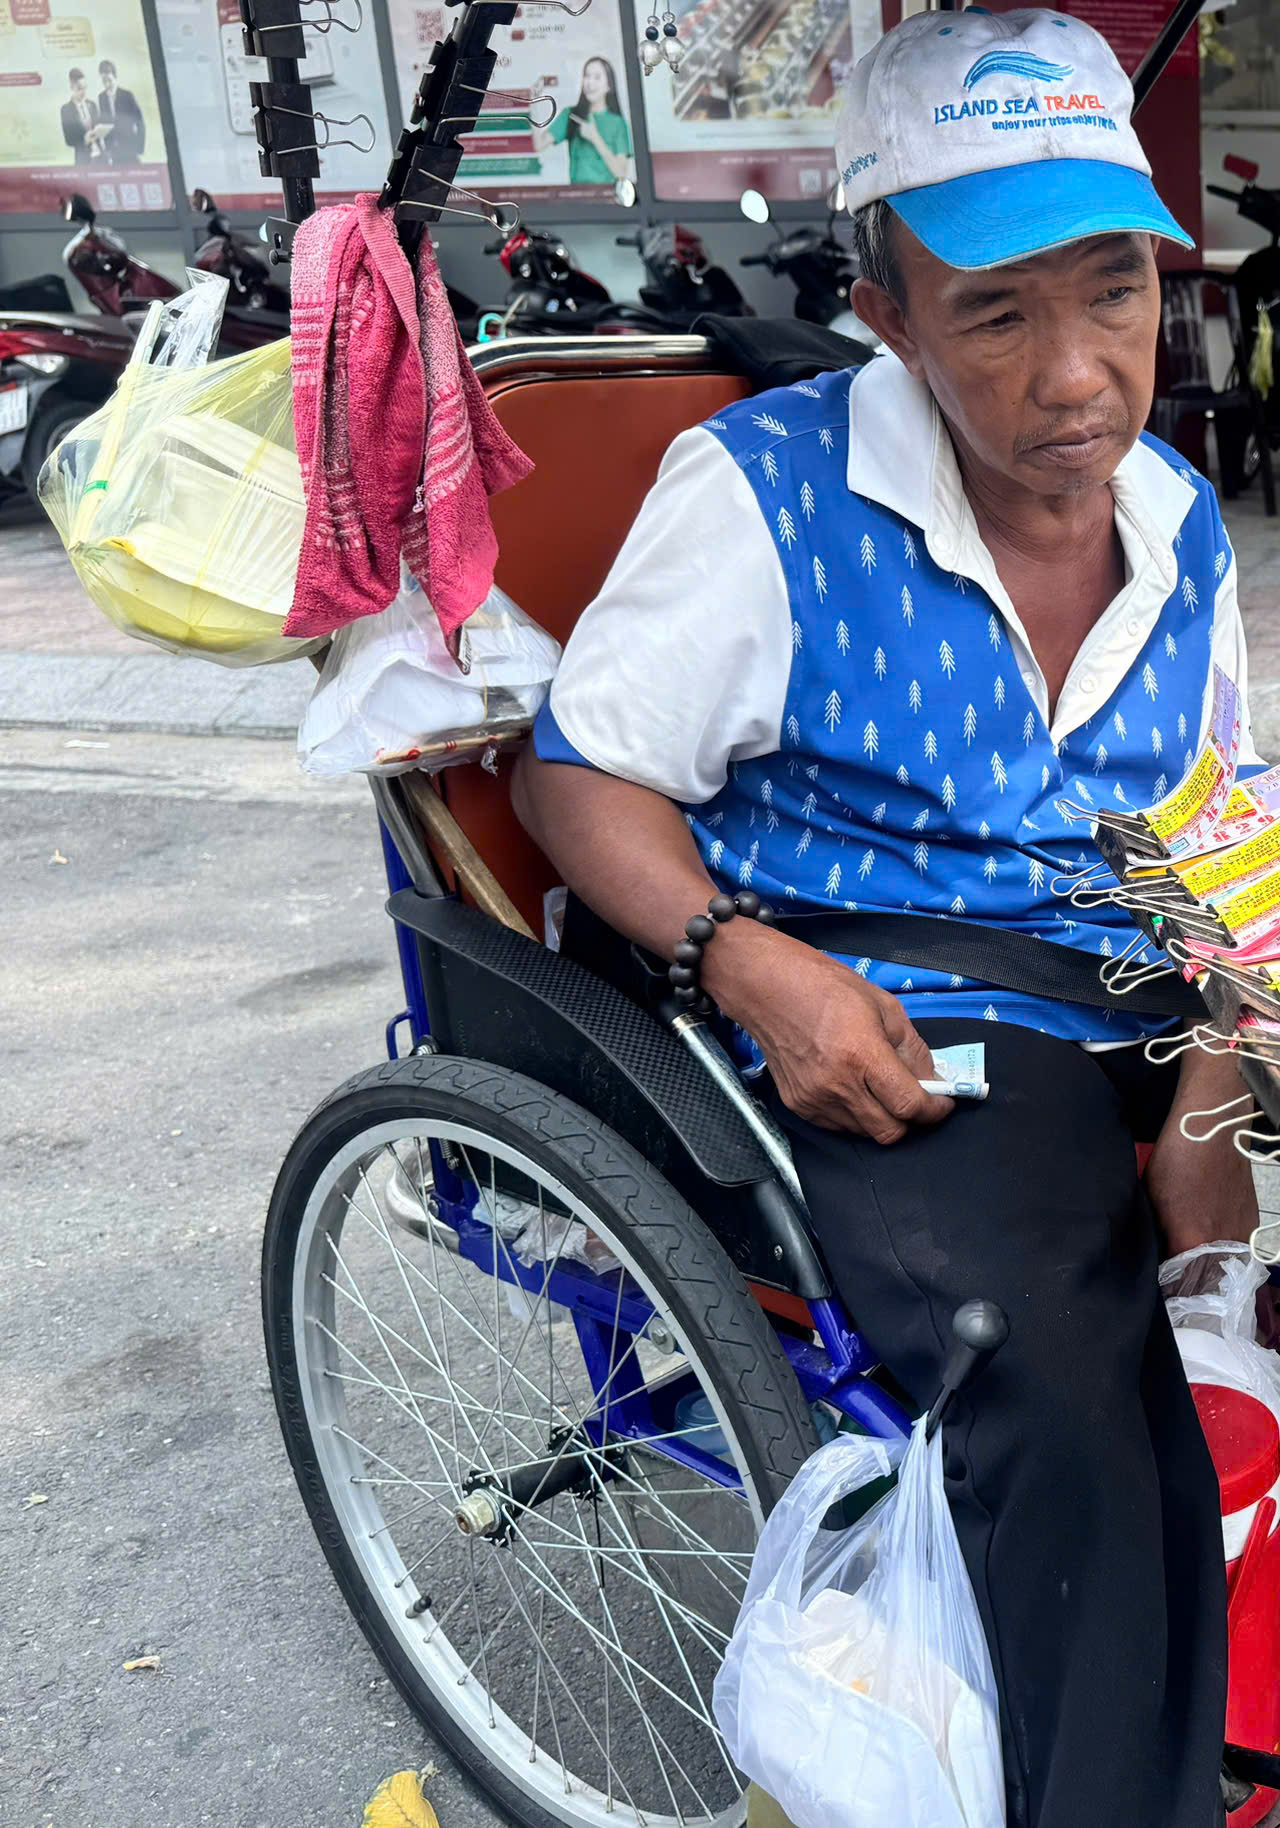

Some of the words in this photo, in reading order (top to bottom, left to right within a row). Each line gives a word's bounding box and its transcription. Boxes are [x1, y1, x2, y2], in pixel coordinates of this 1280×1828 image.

[934, 99, 999, 124] ISLAND
[1002, 97, 1039, 115] SEA
[1044, 94, 1106, 111] TRAVEL
[991, 119, 1019, 130] enjoy
[1022, 117, 1046, 129] your
